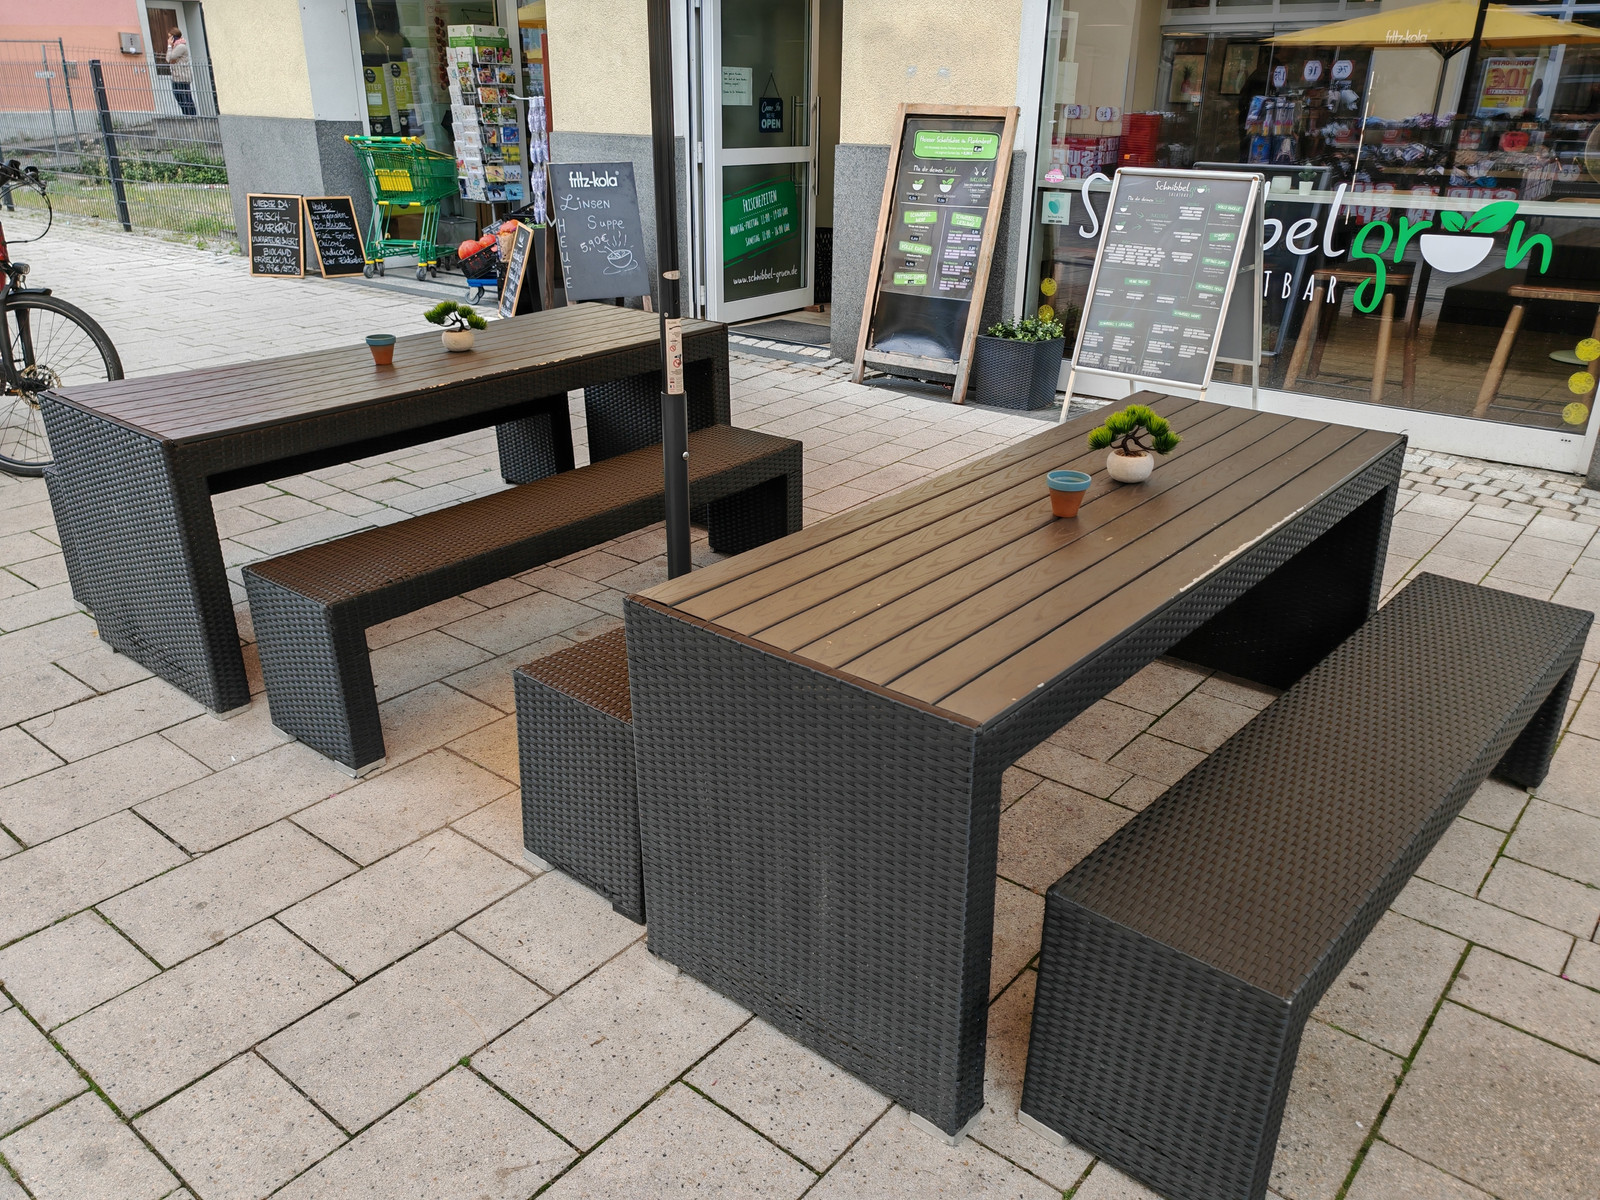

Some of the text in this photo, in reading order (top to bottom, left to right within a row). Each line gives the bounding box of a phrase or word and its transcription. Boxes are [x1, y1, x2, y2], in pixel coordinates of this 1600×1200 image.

[761, 119, 781, 129] OPEN
[569, 171, 618, 188] fritz-kola
[587, 215, 625, 230] Suppe
[1263, 270, 1337, 304] TBAR
